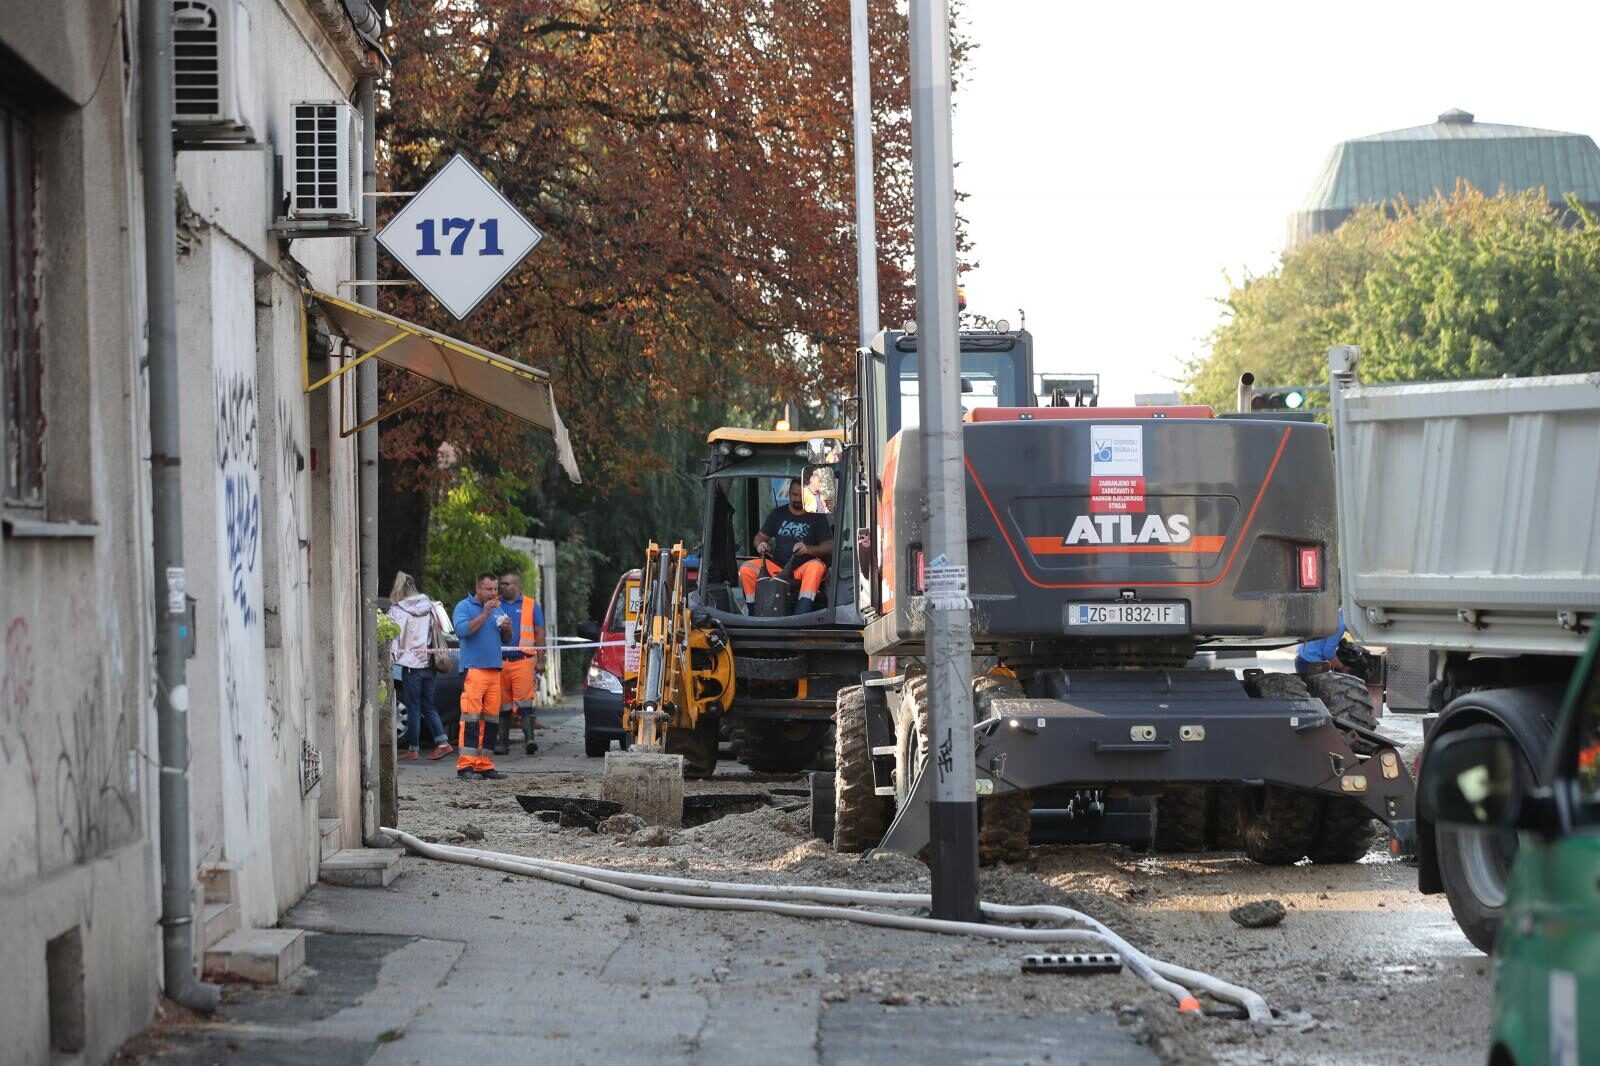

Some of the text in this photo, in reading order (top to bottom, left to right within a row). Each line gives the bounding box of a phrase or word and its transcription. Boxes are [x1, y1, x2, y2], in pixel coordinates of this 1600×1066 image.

[415, 217, 504, 257] 171
[1065, 514, 1190, 544] ATLAS
[1090, 608, 1107, 622] ZG
